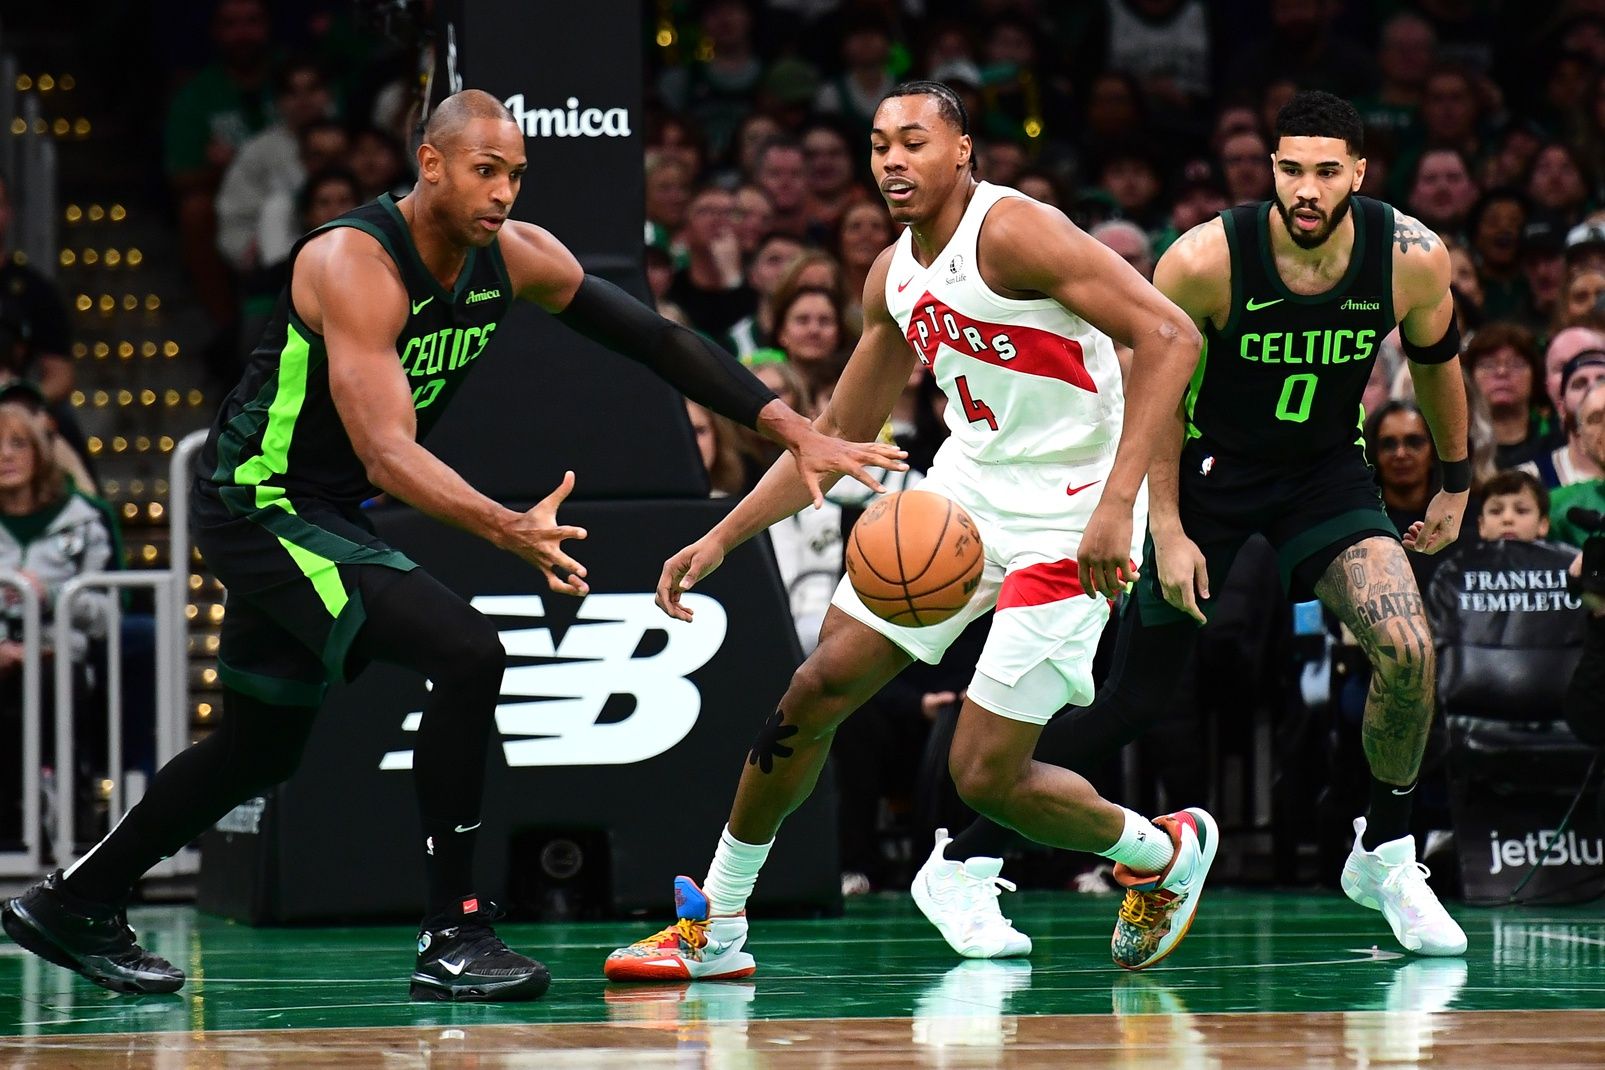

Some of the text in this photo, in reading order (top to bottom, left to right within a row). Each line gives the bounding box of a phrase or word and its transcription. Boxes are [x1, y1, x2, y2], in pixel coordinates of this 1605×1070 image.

[465, 288, 501, 304] Amica
[1340, 299, 1380, 310] Amica
[911, 304, 1017, 365] APTORS
[1240, 329, 1377, 365] CELTICS
[954, 375, 999, 431] 4
[1275, 373, 1319, 423] 0
[1464, 569, 1568, 591] FRANKLI
[1459, 591, 1583, 613] TEMPLETO
[1489, 830, 1604, 875] jetBlu
